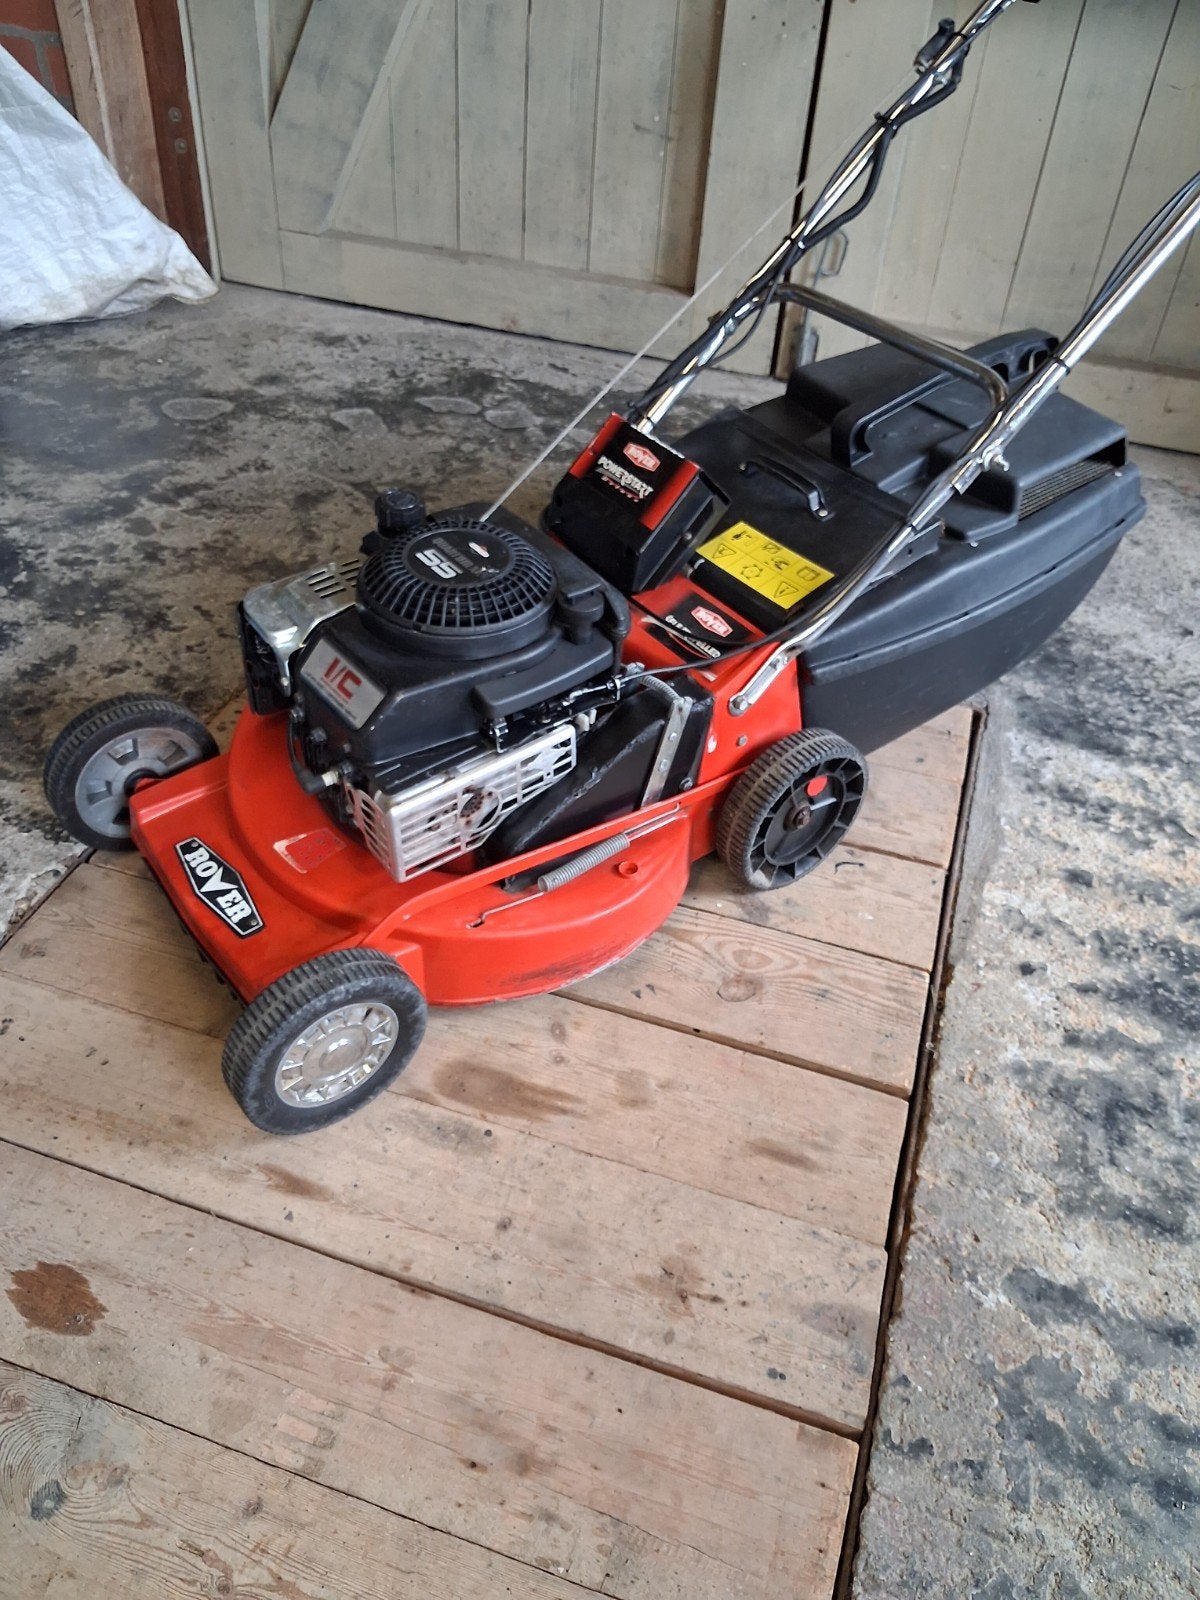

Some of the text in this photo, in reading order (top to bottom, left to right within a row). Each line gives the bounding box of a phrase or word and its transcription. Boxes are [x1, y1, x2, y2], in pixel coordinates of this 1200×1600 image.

[598, 456, 654, 499] POWERSTART
[415, 549, 464, 579] 55
[694, 609, 730, 634] ROVER
[324, 657, 362, 700] I/C
[184, 846, 252, 924] ROVER
